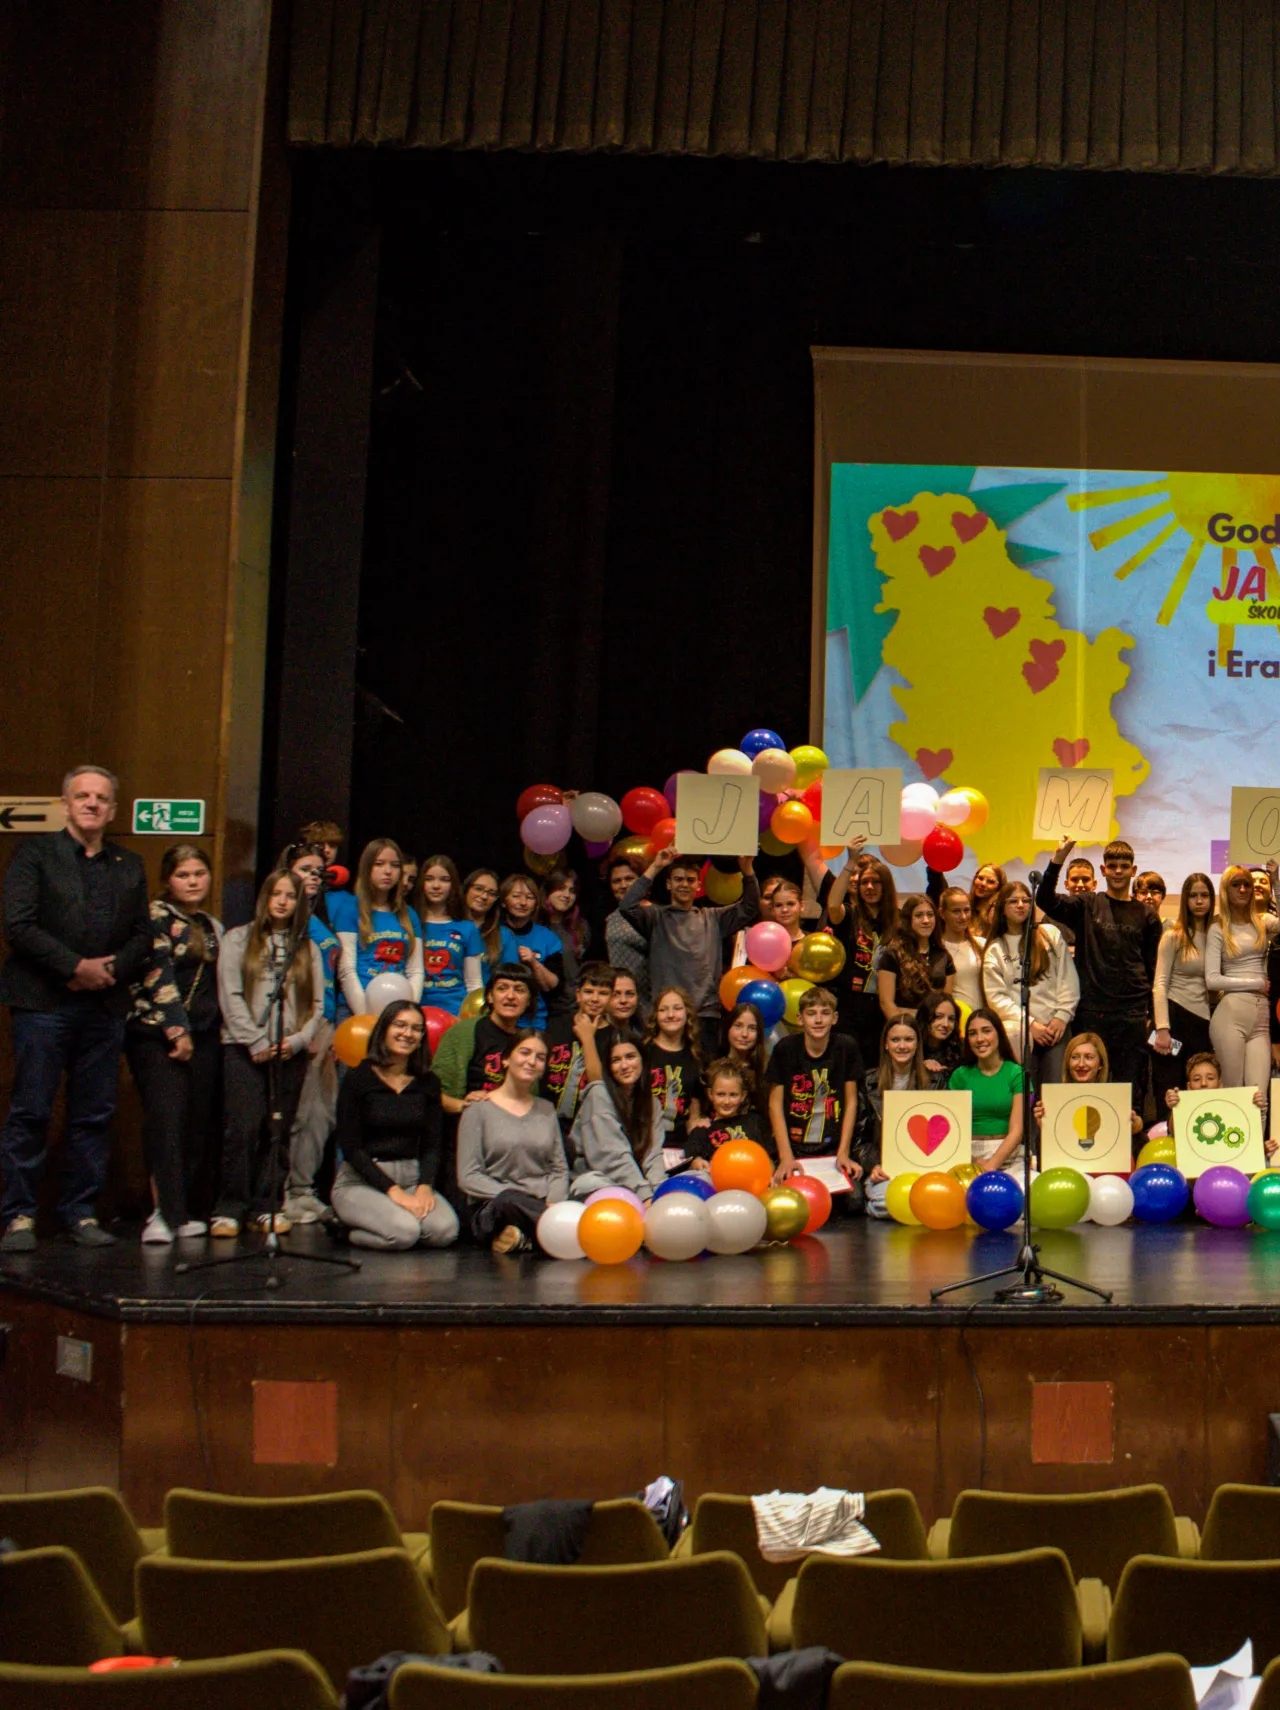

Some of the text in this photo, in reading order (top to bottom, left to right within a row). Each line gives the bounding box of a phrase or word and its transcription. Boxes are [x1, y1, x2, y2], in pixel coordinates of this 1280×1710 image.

[1212, 566, 1266, 602] JA
[1208, 650, 1216, 677] i
[692, 782, 742, 844] J
[833, 776, 885, 837] A
[1038, 774, 1109, 832] M
